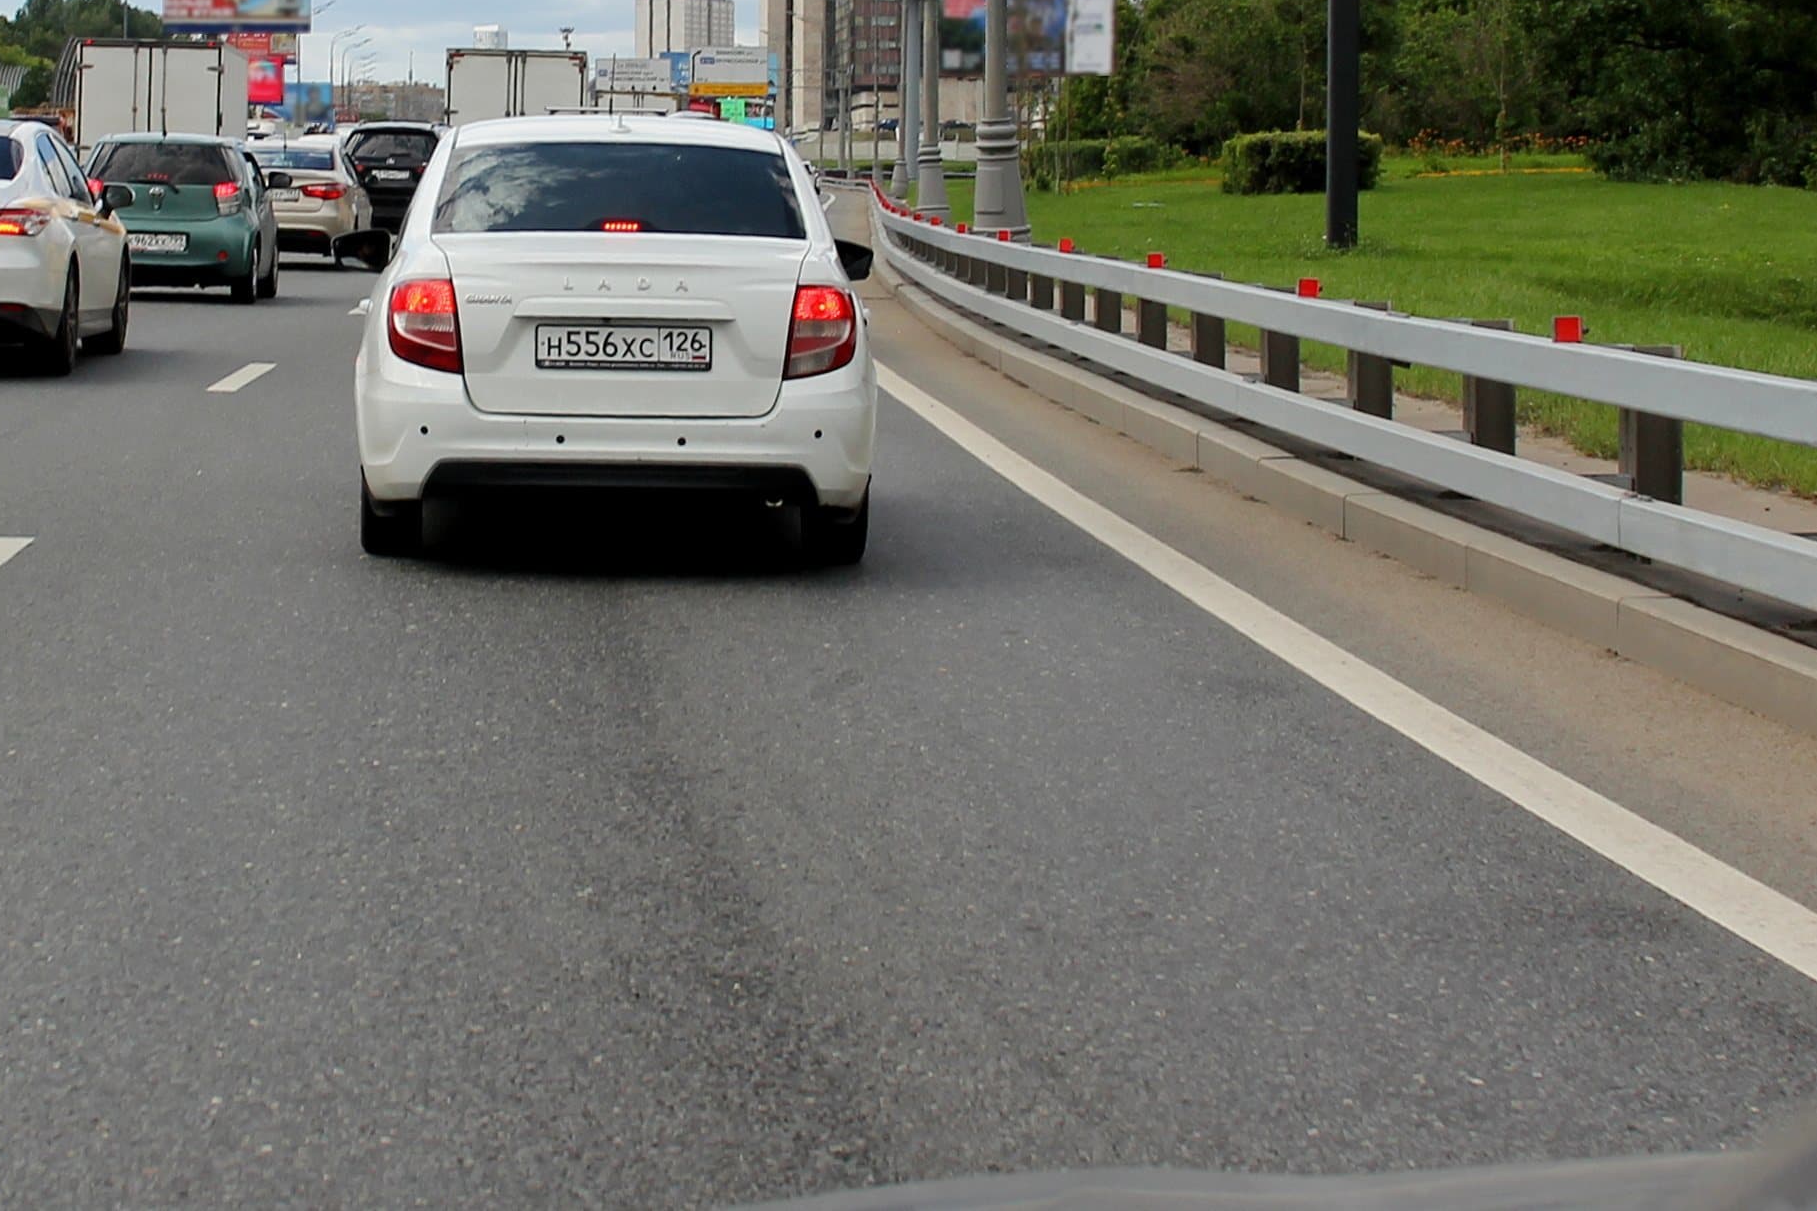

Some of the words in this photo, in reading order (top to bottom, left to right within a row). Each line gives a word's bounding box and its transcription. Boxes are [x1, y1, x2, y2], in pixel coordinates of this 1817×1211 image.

[563, 276, 689, 292] LADA
[546, 330, 655, 358] Н556ХС
[662, 331, 703, 352] 126
